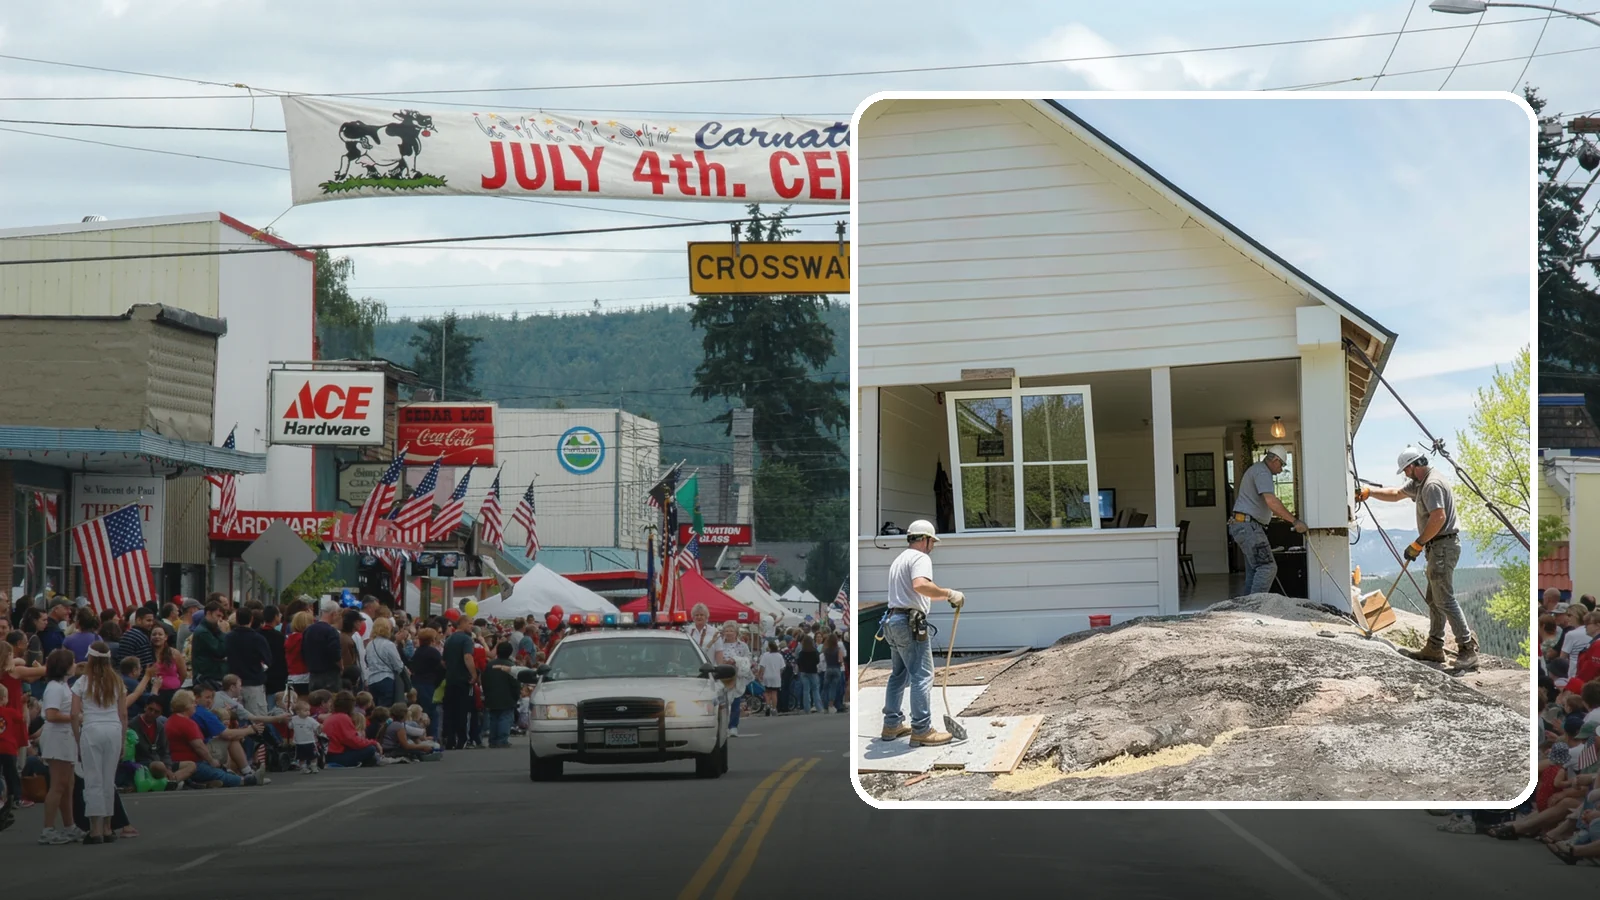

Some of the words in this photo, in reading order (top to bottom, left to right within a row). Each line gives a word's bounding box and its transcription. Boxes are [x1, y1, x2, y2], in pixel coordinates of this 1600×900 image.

[481, 141, 604, 192] JULY
[632, 150, 746, 198] 4th.
[696, 254, 850, 280] CROSSWA
[283, 380, 373, 420] ACE
[406, 409, 452, 422] CEDAR
[461, 409, 485, 422] LOG
[283, 421, 370, 436] Hardware
[416, 428, 476, 447] Coca-Cola
[353, 466, 385, 480] Simpl
[83, 485, 93, 494] St.
[96, 485, 123, 495] Vincent
[126, 486, 136, 495] de
[138, 486, 155, 495] Paul
[213, 516, 330, 536] HARDARE
[688, 526, 741, 535] CRNATION
[699, 535, 730, 543] GLASS
